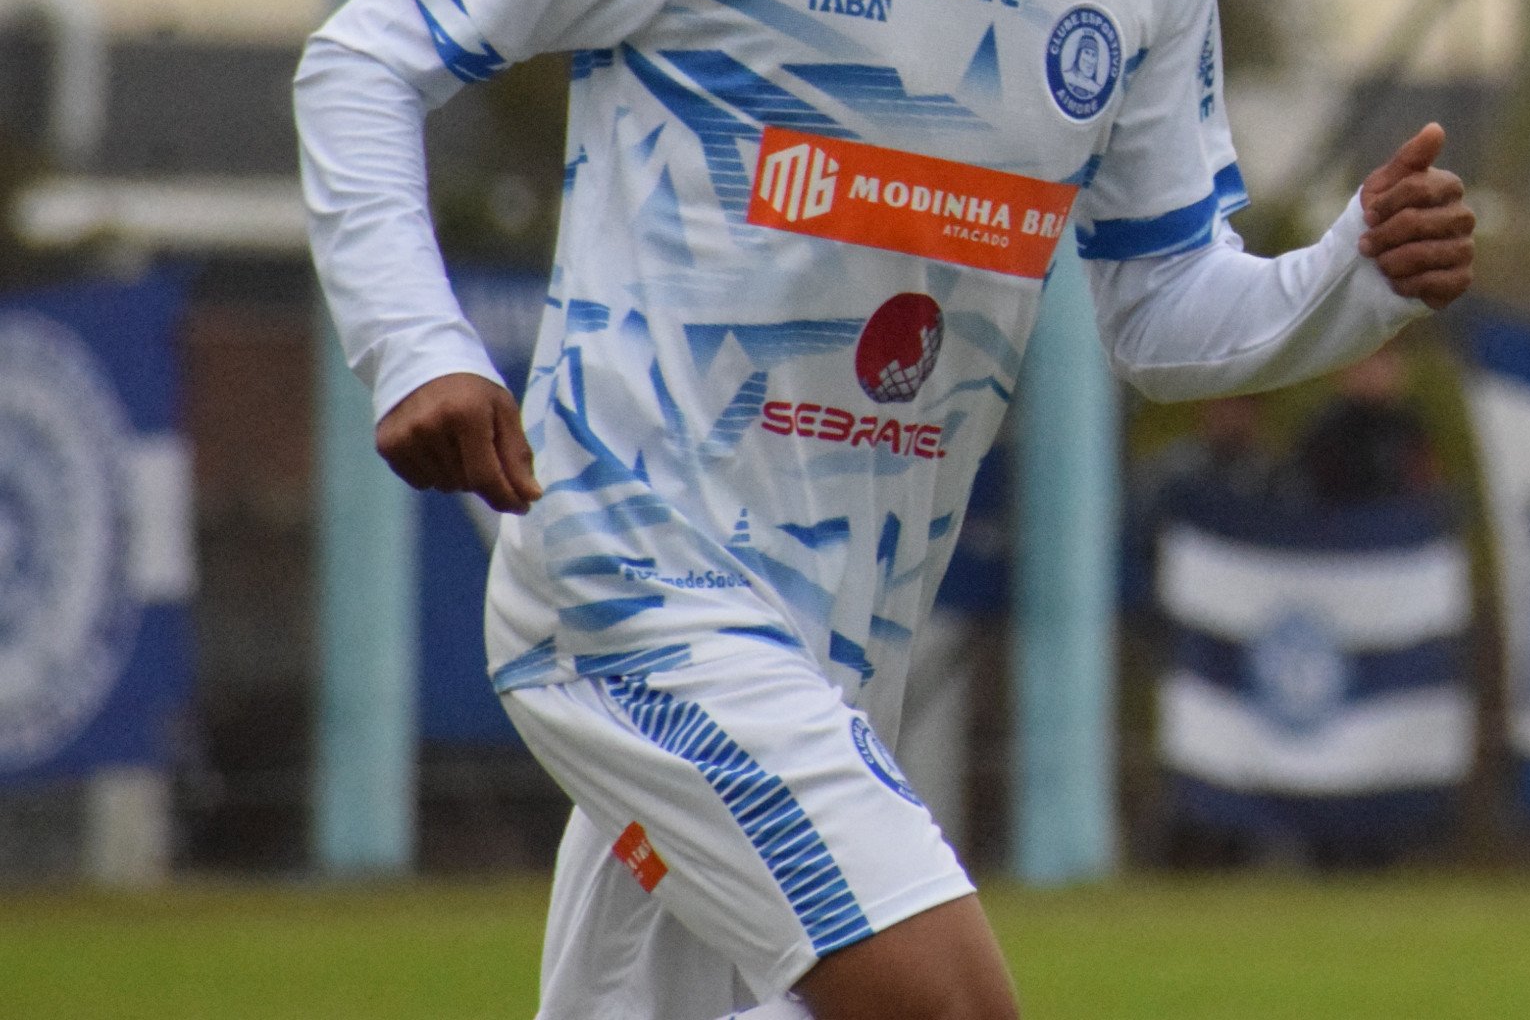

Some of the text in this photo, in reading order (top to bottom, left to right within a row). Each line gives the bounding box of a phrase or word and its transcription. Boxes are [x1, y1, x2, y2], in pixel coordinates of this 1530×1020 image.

[848, 174, 1011, 230] MODINHA
[943, 223, 1010, 248] ATACADO
[761, 400, 946, 459] SEBRATE
